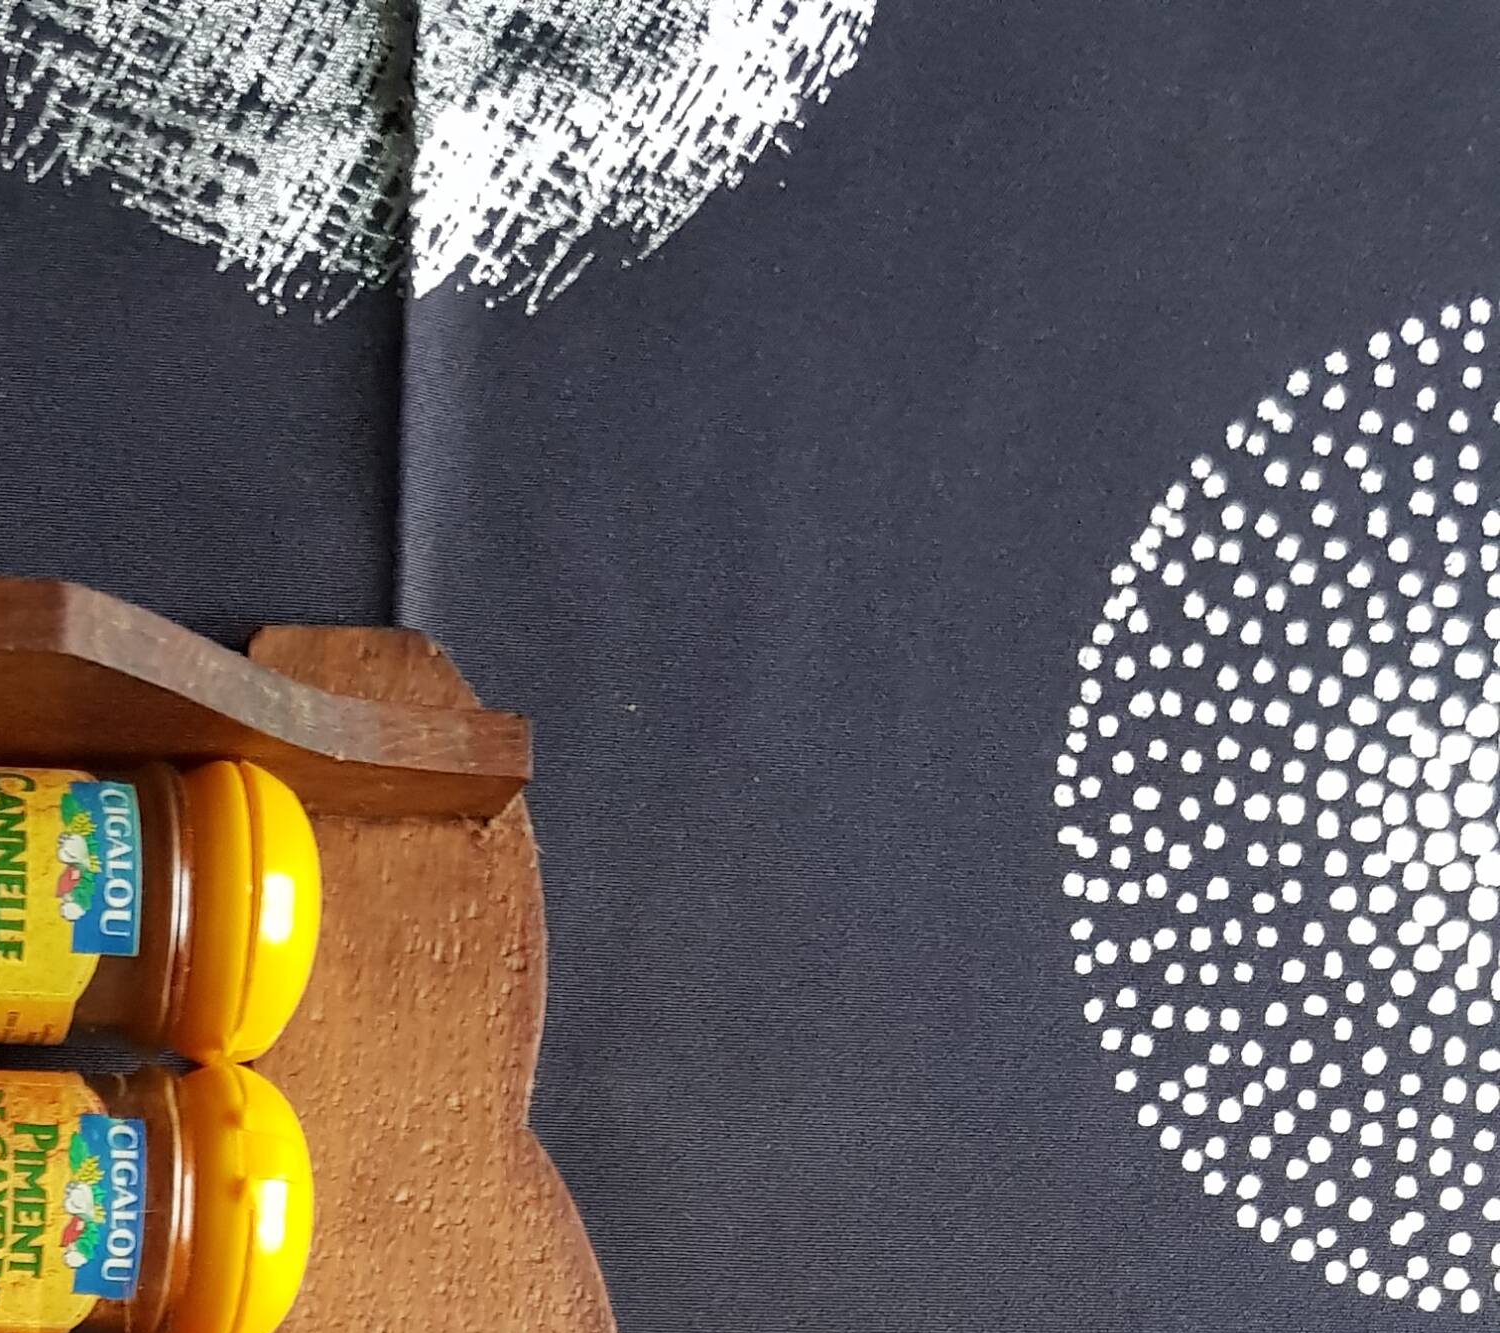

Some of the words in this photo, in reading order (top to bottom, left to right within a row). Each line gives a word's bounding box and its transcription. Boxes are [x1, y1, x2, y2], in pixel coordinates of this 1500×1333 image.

[98, 789, 134, 936] CIGALOU
[8, 1122, 59, 1278] PIMENT
[102, 1124, 139, 1282] CIGALOU
